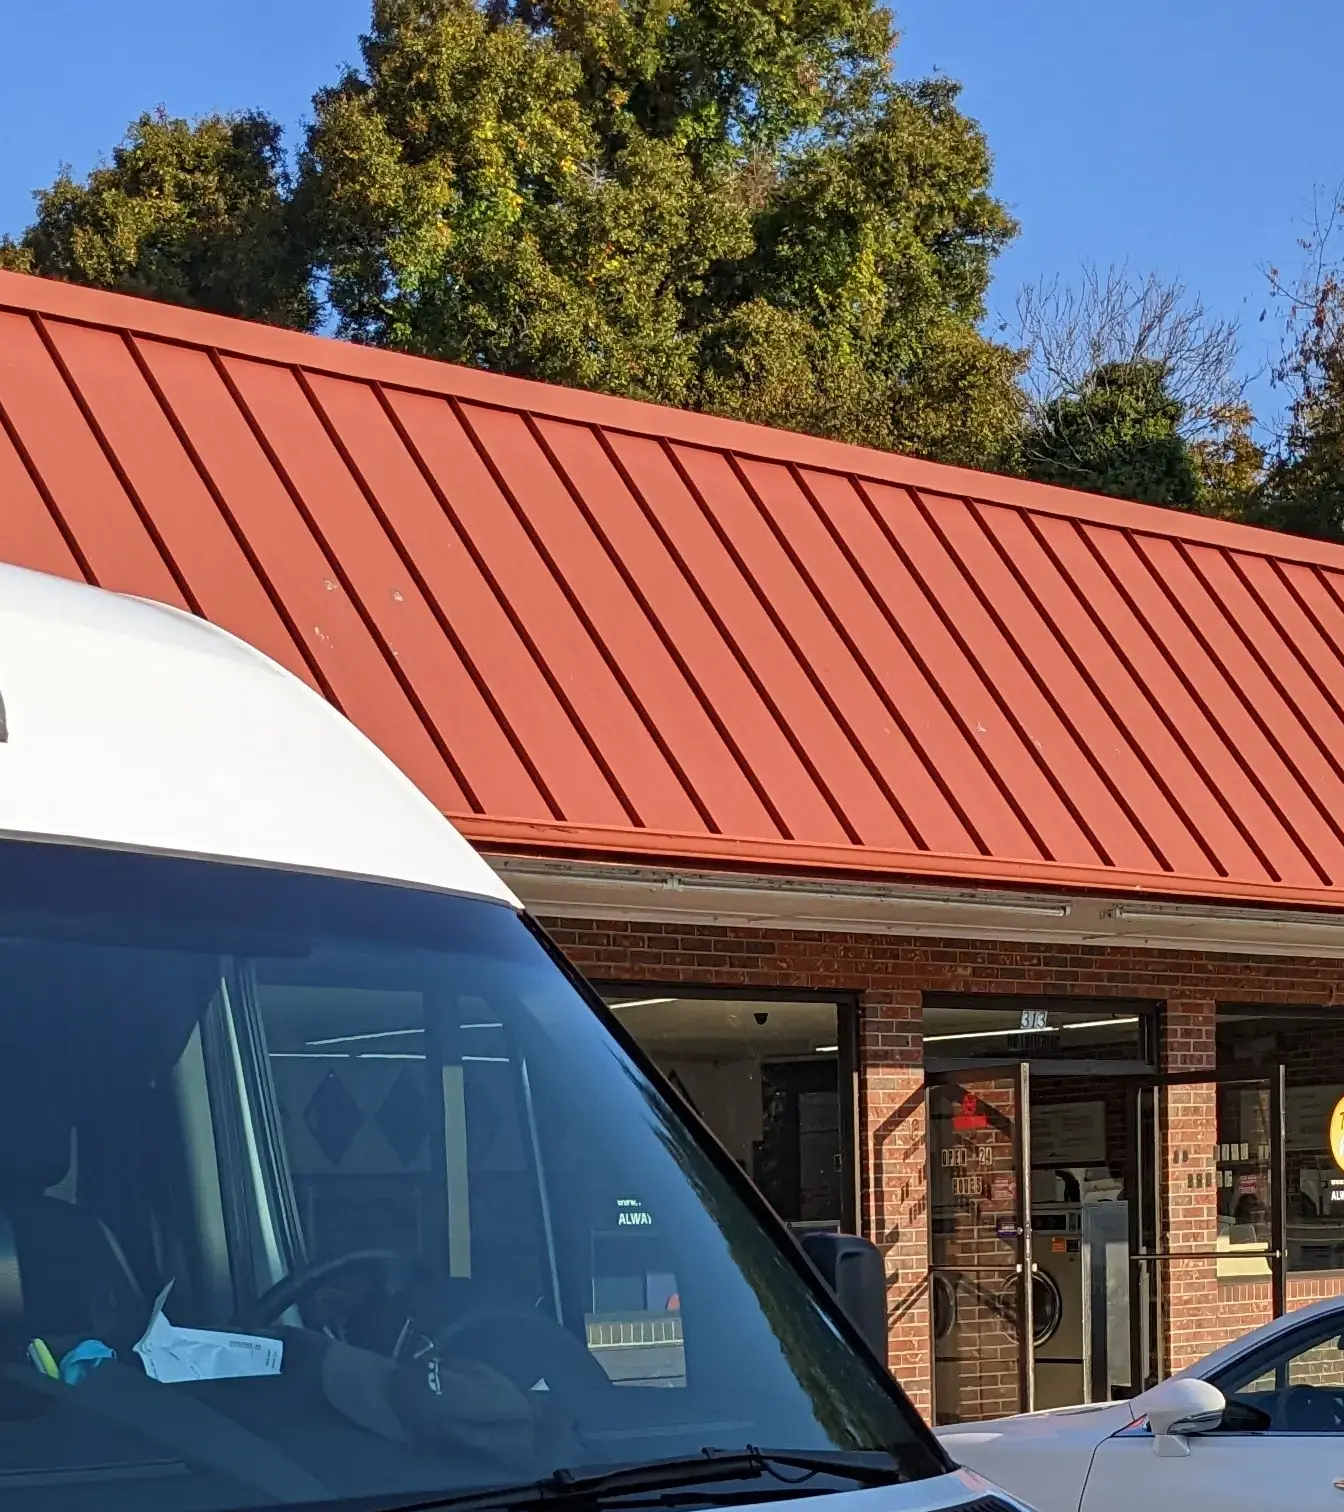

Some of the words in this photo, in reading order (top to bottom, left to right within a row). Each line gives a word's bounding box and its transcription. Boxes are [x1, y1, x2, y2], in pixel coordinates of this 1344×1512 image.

[1020, 1011, 1047, 1028] 313
[942, 1149, 966, 1166] OPEN
[979, 1147, 992, 1164] 24
